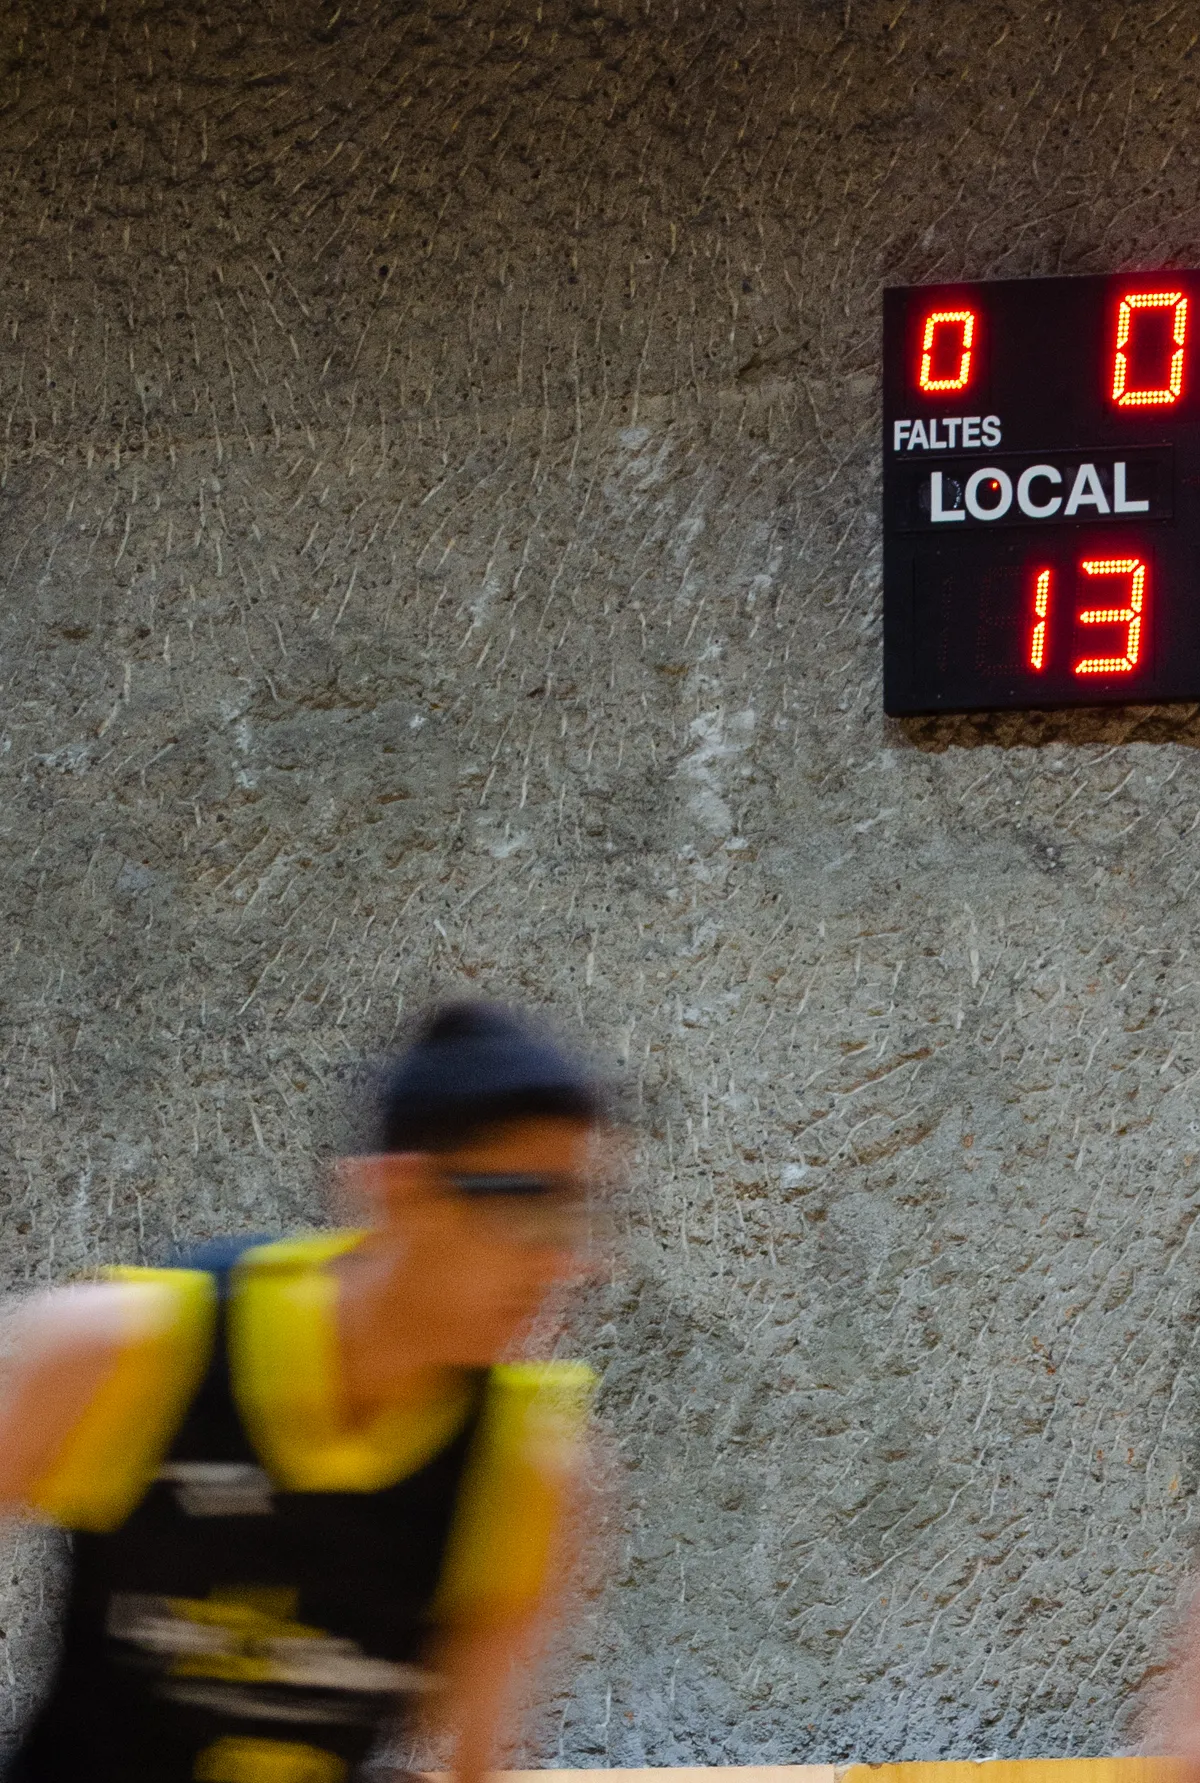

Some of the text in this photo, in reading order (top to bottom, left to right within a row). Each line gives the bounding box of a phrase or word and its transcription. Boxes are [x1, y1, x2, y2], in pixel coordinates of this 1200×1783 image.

[918, 310, 975, 392] 0
[893, 415, 1002, 451] FALTES
[929, 461, 1149, 523] LOCAL
[1029, 557, 1147, 675] 13
